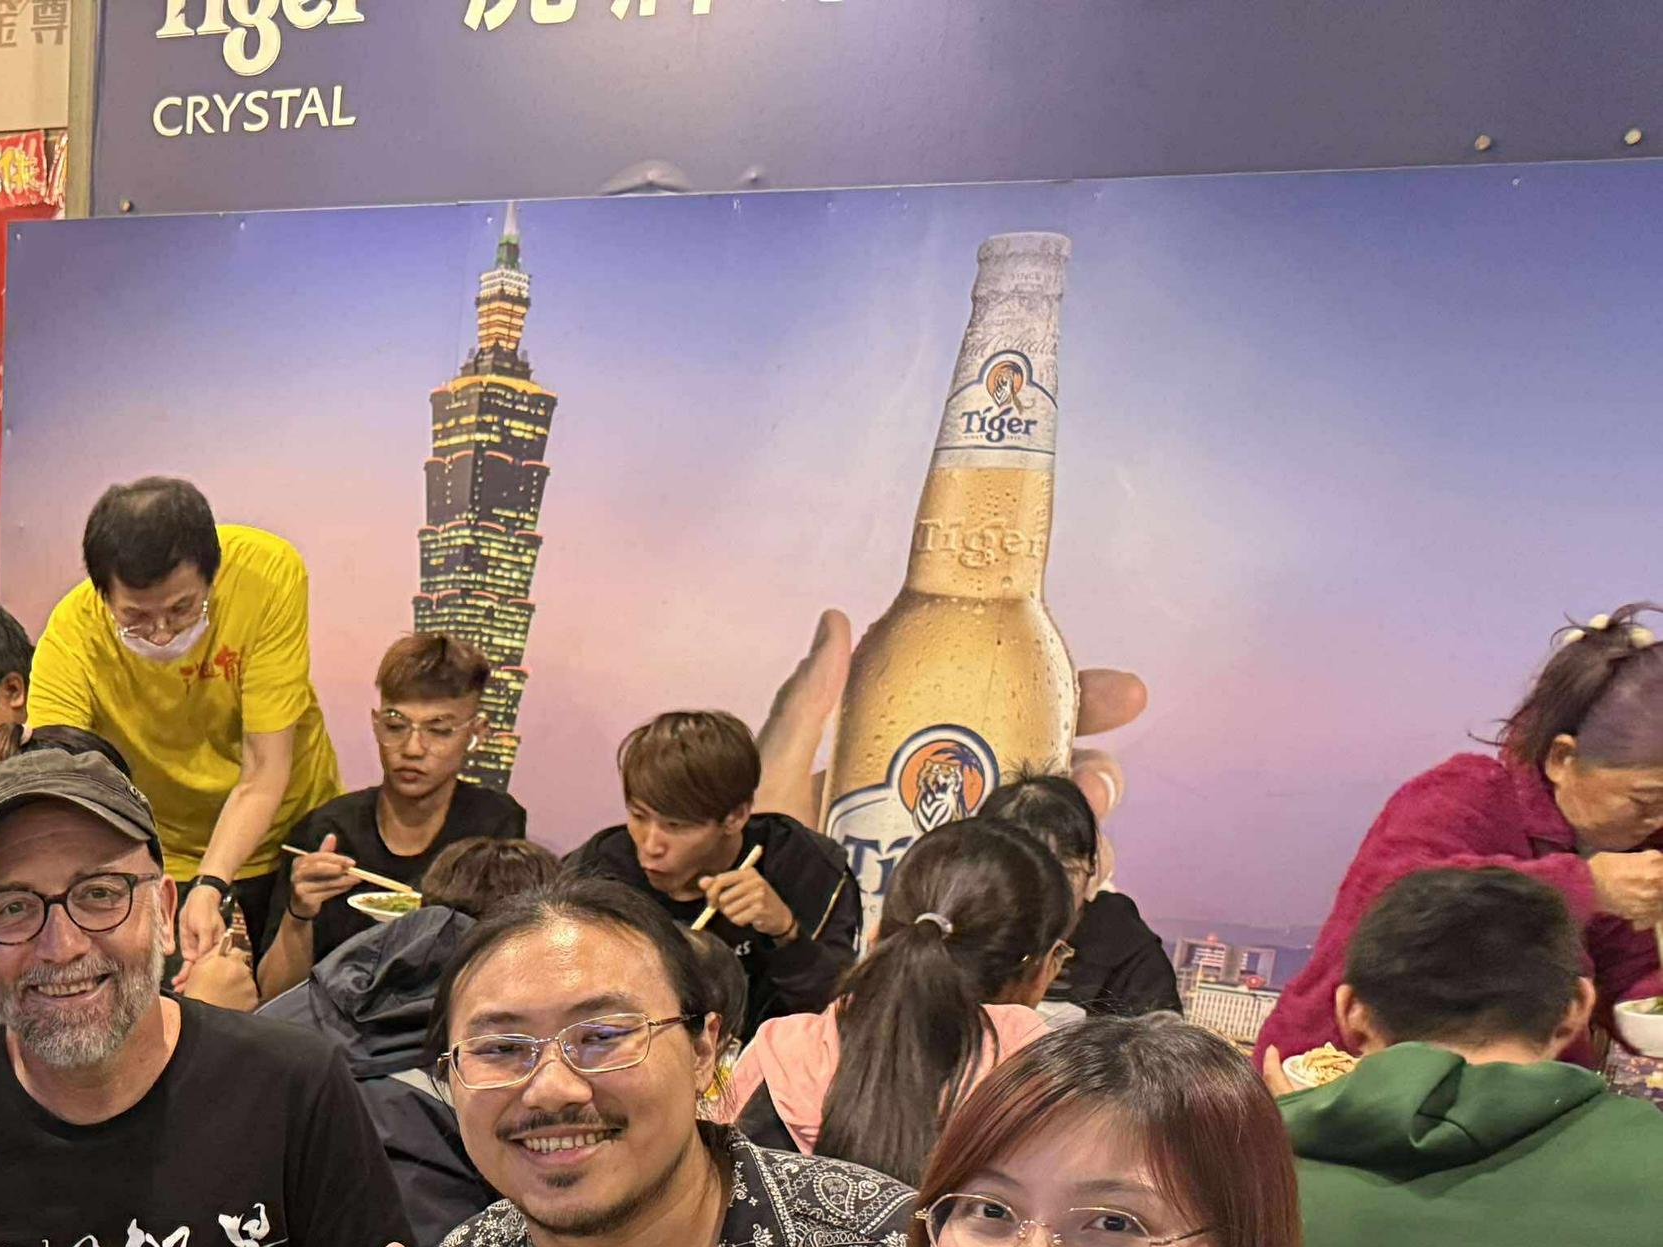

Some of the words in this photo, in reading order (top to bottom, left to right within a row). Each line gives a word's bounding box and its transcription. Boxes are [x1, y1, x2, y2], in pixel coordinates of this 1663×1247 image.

[153, 85, 356, 137] CRYSTAL
[961, 405, 1038, 443] Tiger
[917, 517, 1043, 570] Tiger
